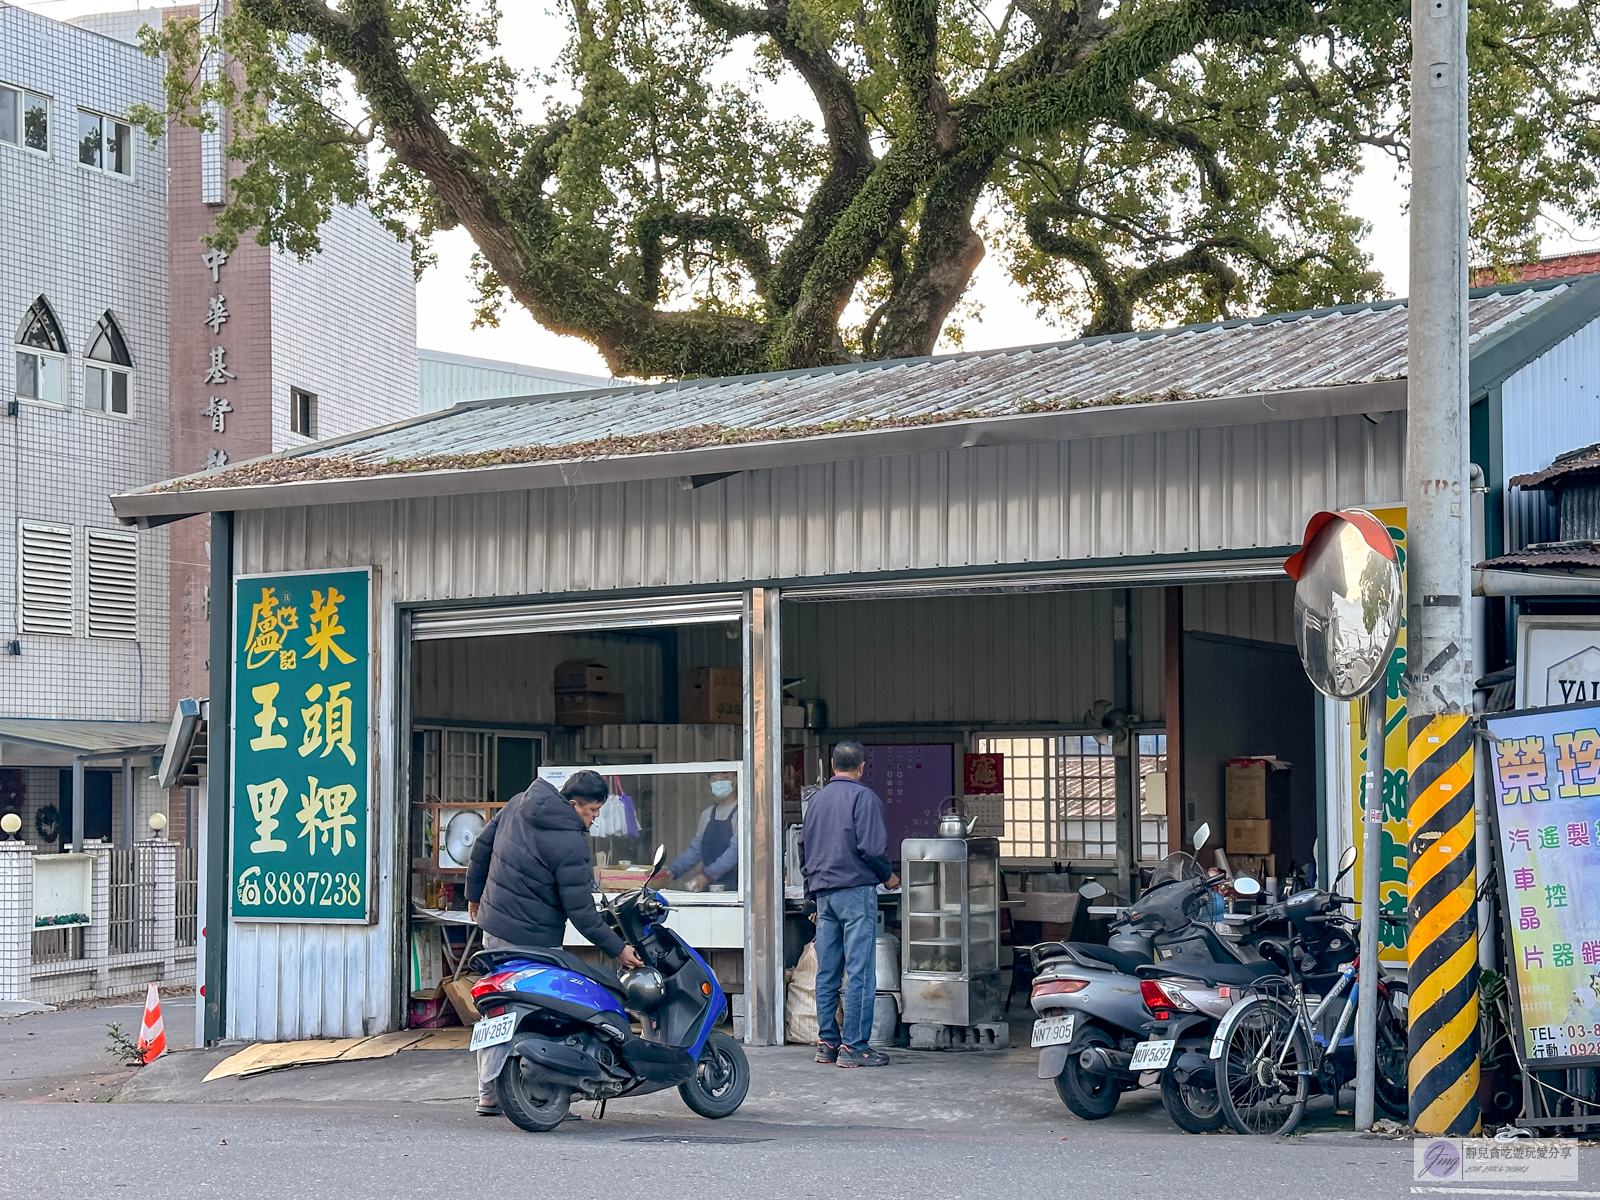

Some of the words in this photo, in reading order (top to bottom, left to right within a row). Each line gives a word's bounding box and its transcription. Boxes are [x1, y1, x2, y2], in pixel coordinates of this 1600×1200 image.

[295, 586, 357, 857] 菜頭粿
[1497, 727, 1600, 805] 榮珍
[264, 871, 361, 907] 8887238
[1508, 828, 1544, 970] 汽車晶片
[1537, 825, 1575, 967] 遙控器
[472, 1020, 513, 1045] MUV-2837
[1132, 1048, 1171, 1063] MUV-5692
